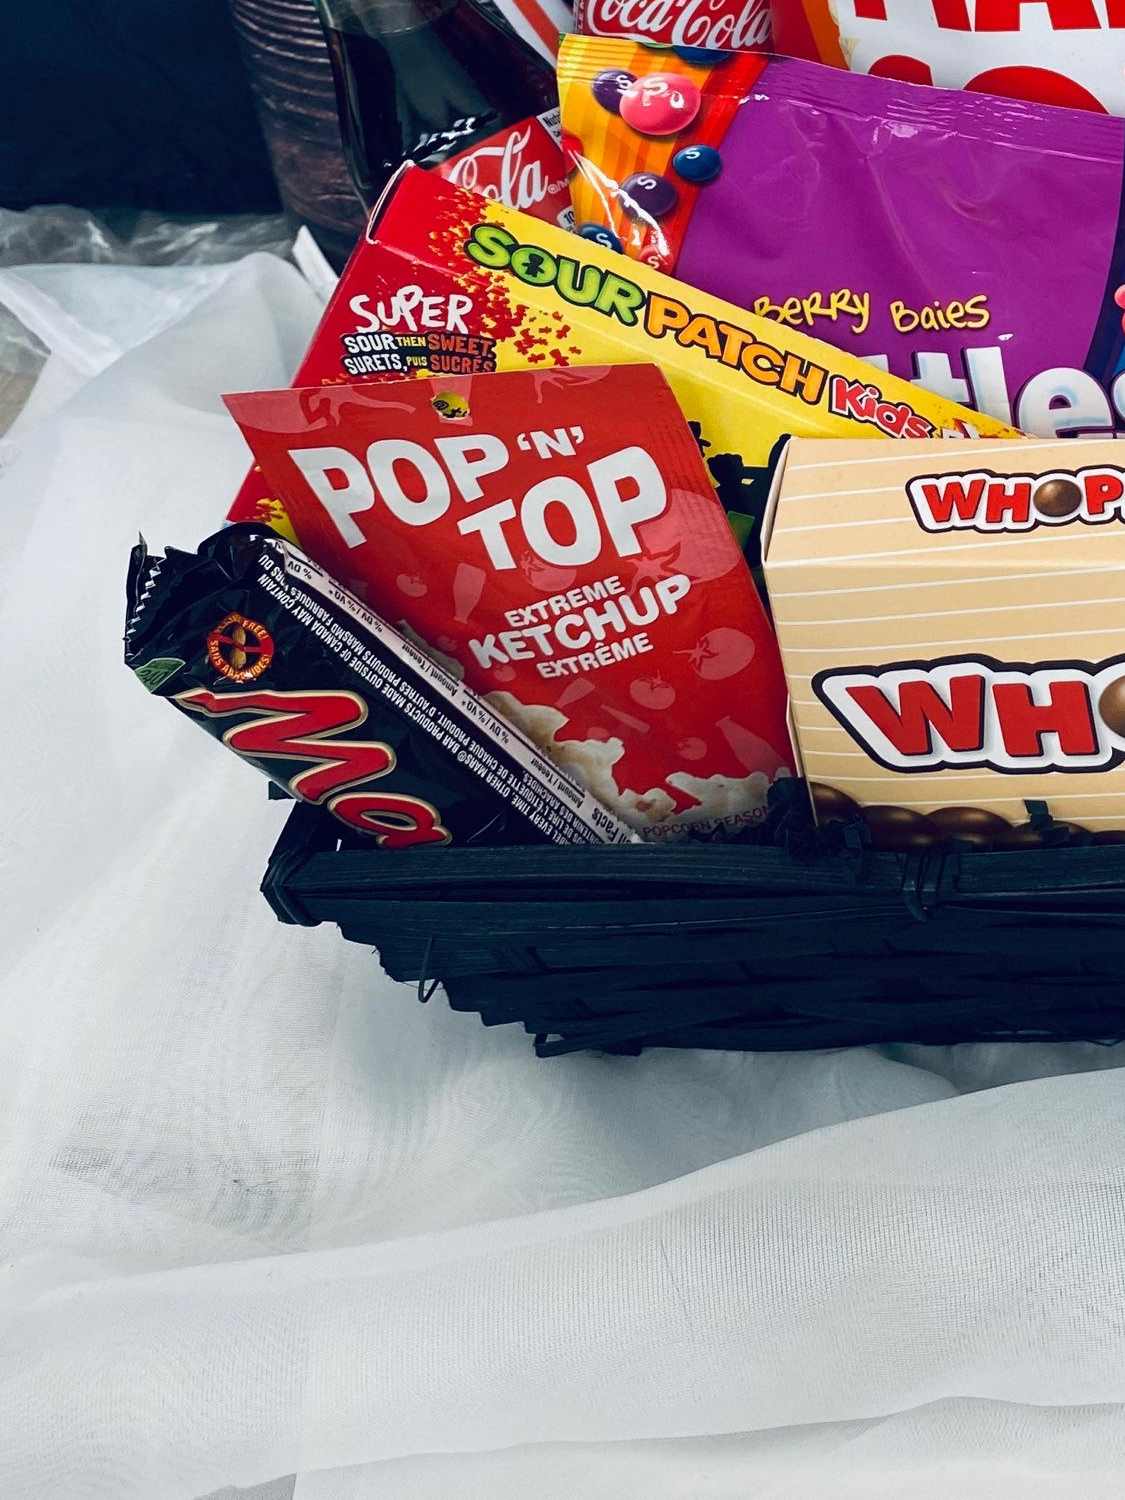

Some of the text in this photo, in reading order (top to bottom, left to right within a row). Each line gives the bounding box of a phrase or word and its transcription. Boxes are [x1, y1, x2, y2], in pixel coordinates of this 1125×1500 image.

[349, 284, 474, 334] SUPER
[891, 294, 991, 334] Baies
[343, 333, 399, 354] SOUR
[395, 336, 427, 348] THEN
[465, 222, 936, 440] SOUR PATCH Kids
[344, 353, 494, 376] SURETS, PUIS SUCRÉS
[287, 432, 510, 550] POP
[457, 446, 668, 571] TOP
[257, 552, 275, 570] DU
[256, 571, 296, 609] CONTAIN
[288, 583, 334, 626] FABRIQUÉS
[504, 575, 627, 628] EXTREME
[291, 603, 314, 626] MAY
[468, 574, 692, 670] KETCHUP
[308, 619, 344, 653] CANADA
[329, 620, 366, 656] MARSMD
[338, 646, 353, 661] OF
[347, 654, 385, 690] OUTSIDE
[361, 648, 402, 687] PRODUITS
[536, 632, 654, 679] EXTRÊME
[379, 682, 407, 709] MADE
[397, 680, 437, 718] D'AUTRES
[401, 700, 445, 741] PRODUCTS
[432, 710, 472, 747] PRODUIT.
[440, 733, 461, 754] BAR
[466, 739, 500, 771] CHAQUE
[172, 690, 451, 849] Ma
[483, 770, 513, 798] OTHER
[495, 764, 510, 779] DE
[506, 791, 533, 816] TIME.
[545, 809, 566, 829] LIRE
[527, 809, 555, 835] EVERY
